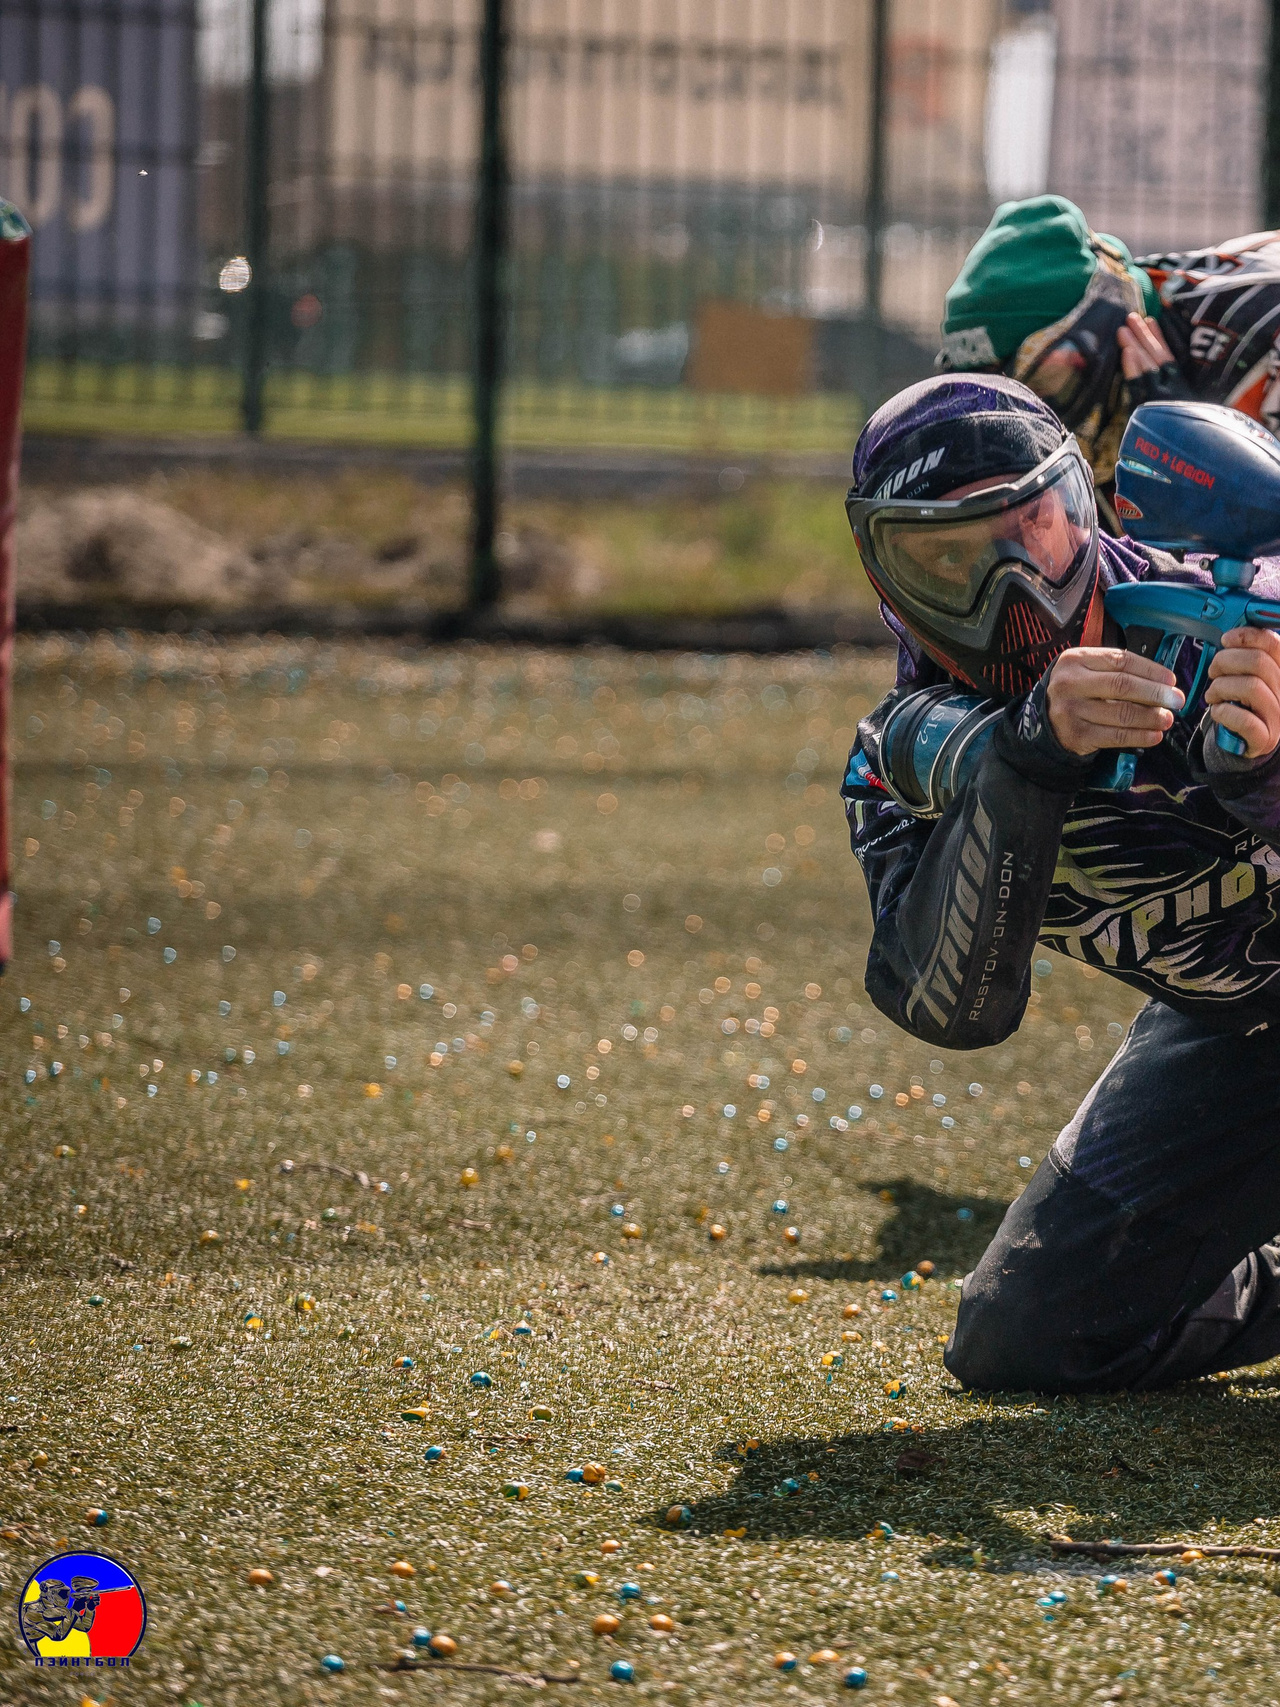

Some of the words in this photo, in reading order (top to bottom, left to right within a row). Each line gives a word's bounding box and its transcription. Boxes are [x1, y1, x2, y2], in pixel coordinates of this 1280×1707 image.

[1134, 437, 1160, 461] RED
[1169, 455, 1216, 490] LEGION
[906, 791, 993, 1029] TYPHOON
[968, 851, 1015, 1022] ROSTOV-ON-DON
